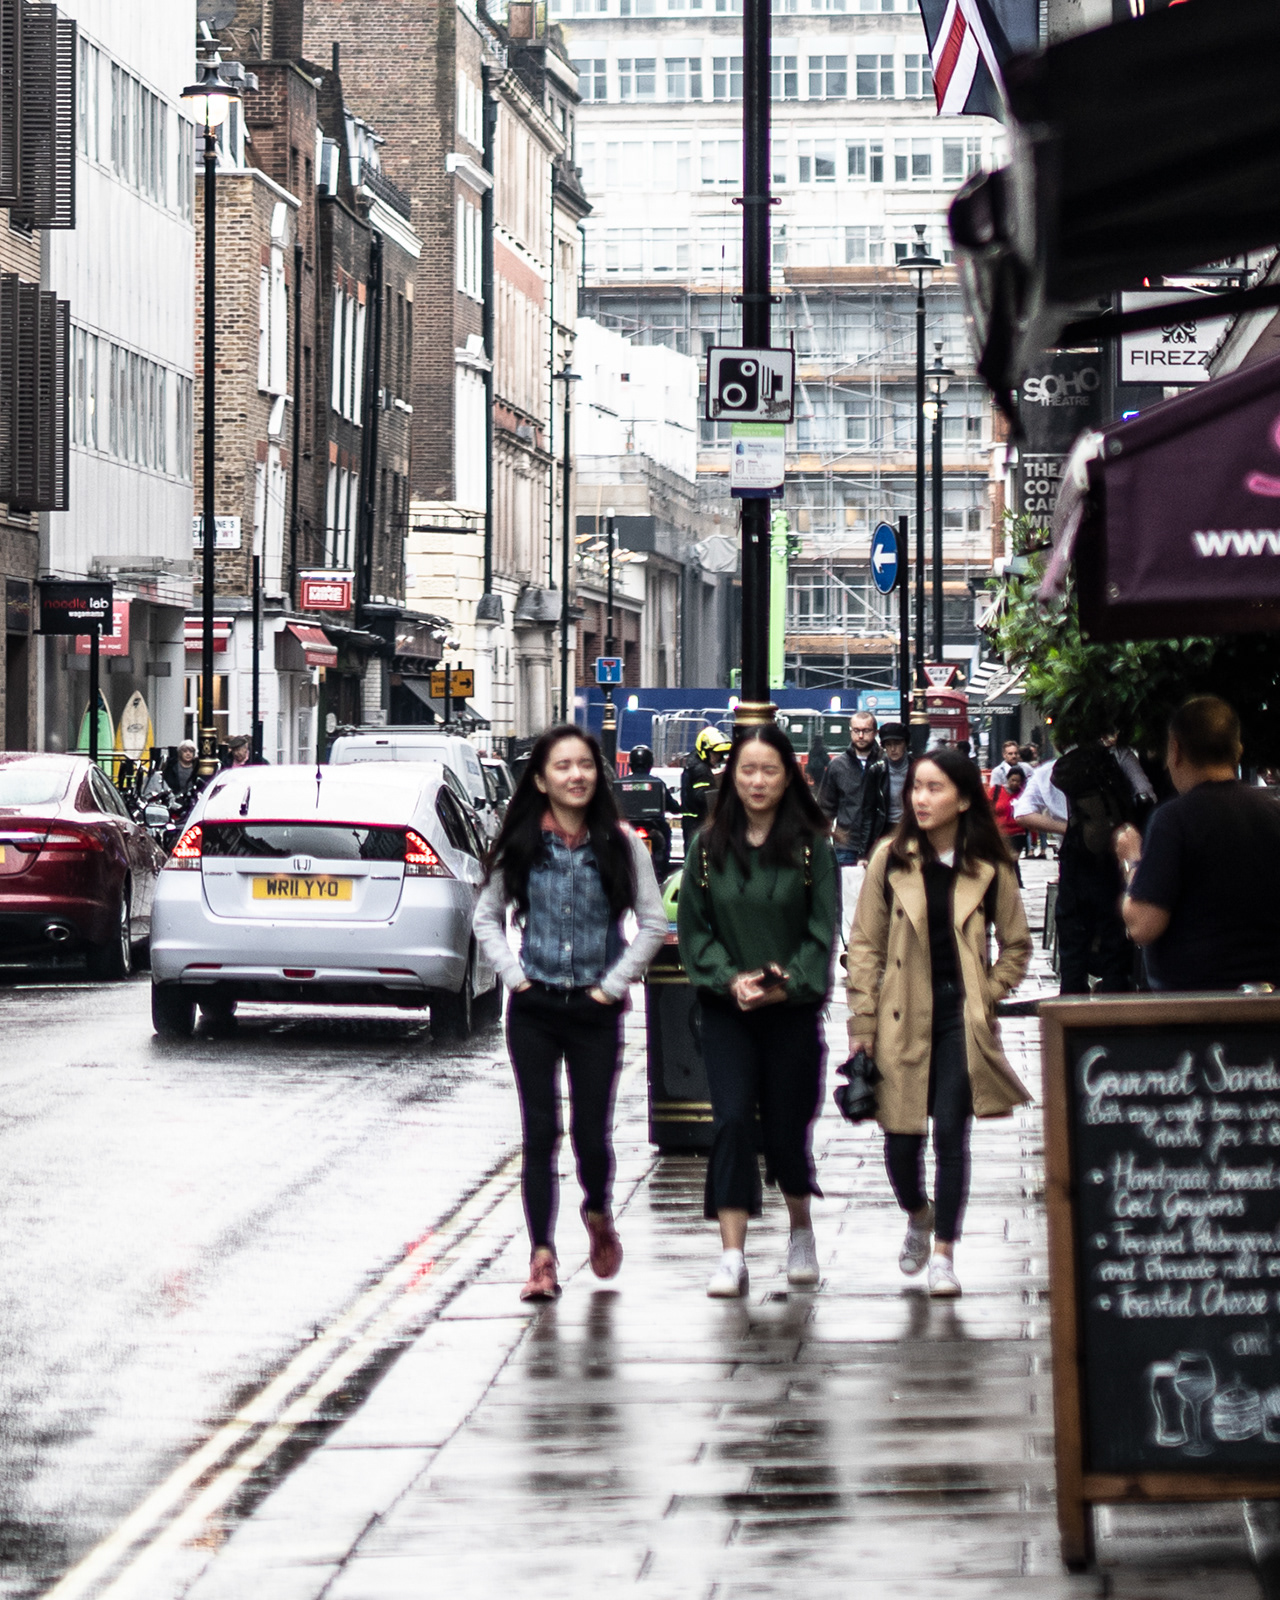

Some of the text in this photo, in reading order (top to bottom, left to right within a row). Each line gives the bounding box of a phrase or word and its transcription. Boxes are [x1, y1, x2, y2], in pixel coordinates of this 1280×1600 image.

[1130, 350, 1209, 365] FIREZZ
[1023, 367, 1101, 402] SOHO
[1040, 395, 1090, 407] THEATRE
[43, 597, 109, 609] noodle lab
[928, 667, 950, 675] GIVE
[267, 879, 299, 896] WR11
[1078, 1044, 1196, 1104] Gourmet
[1114, 1191, 1158, 1218] Cod
[1118, 1284, 1196, 1318] Toasted
[1201, 1279, 1268, 1315] Cheese
